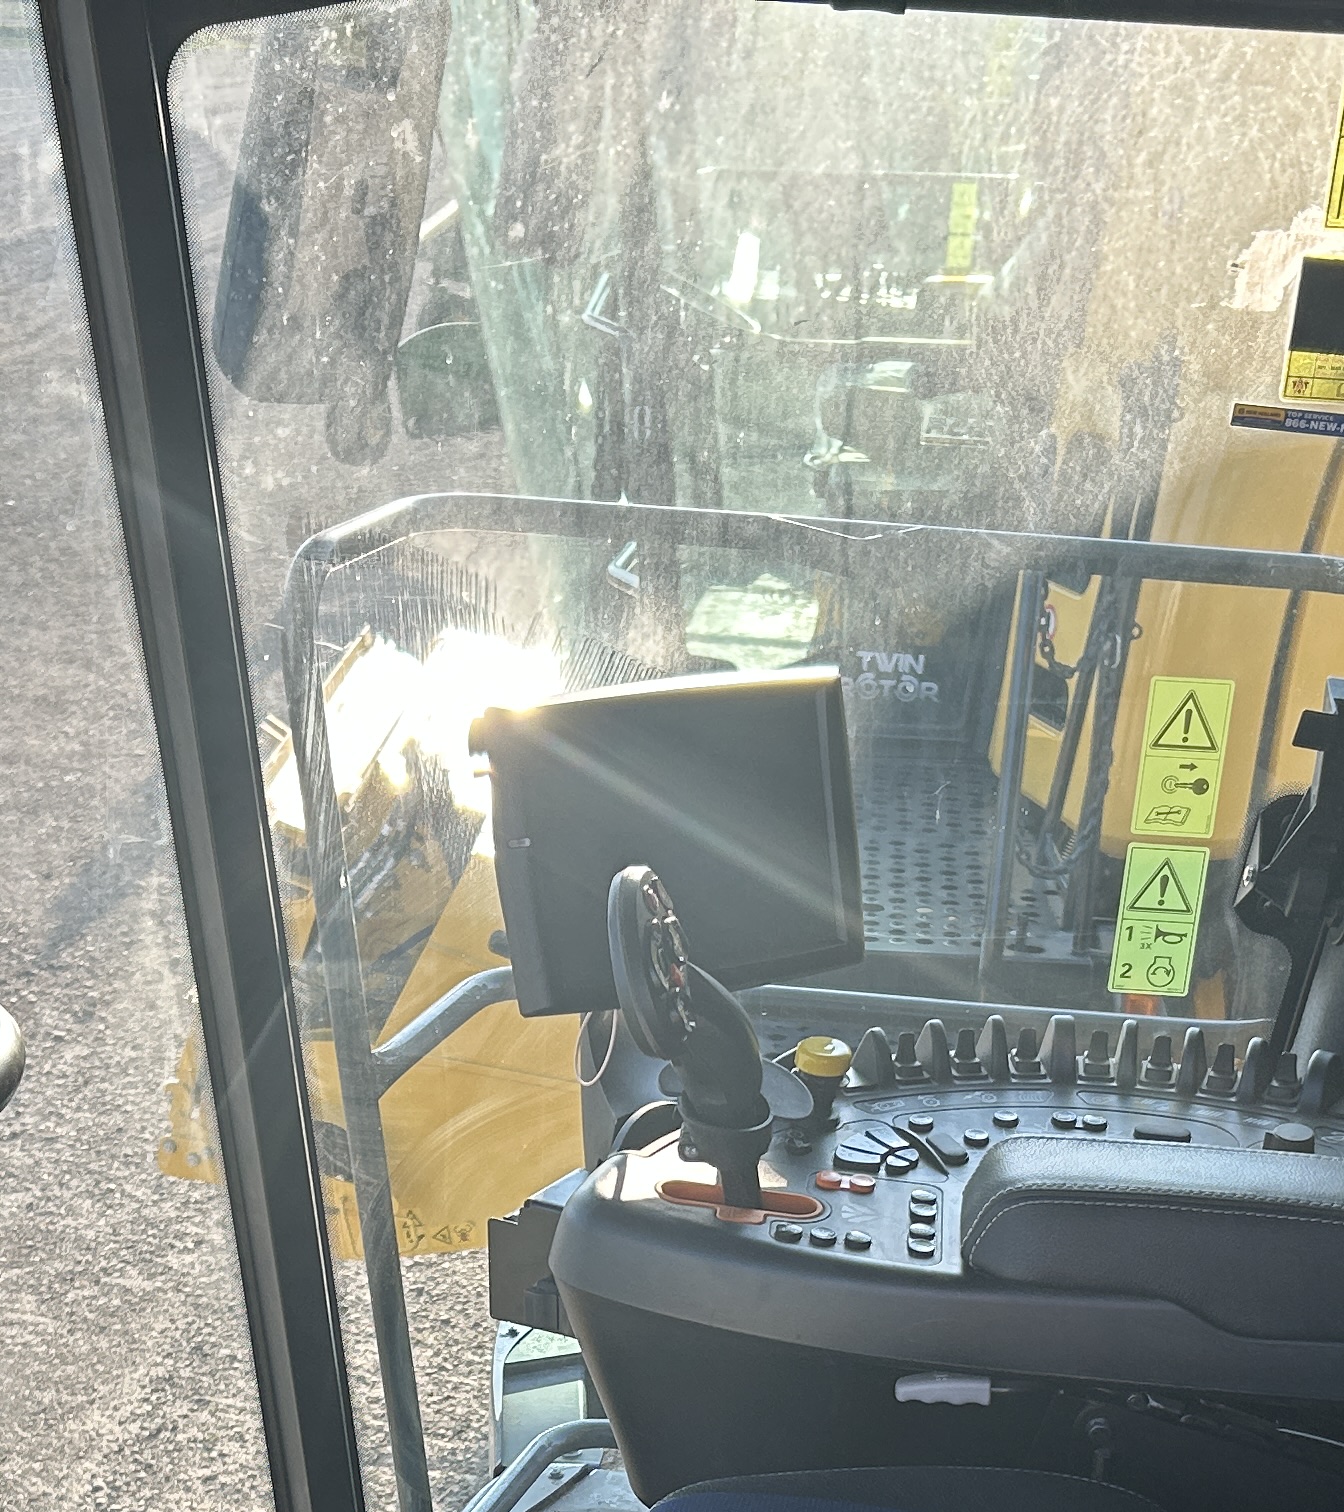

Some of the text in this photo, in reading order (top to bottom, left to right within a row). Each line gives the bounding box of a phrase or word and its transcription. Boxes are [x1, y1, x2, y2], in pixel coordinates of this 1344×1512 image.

[1304, 412, 1334, 421] SERVICE
[856, 650, 926, 675] TWIN
[1125, 925, 1134, 941] 1
[1140, 942, 1153, 950] 3X
[1119, 962, 1133, 978] 2
